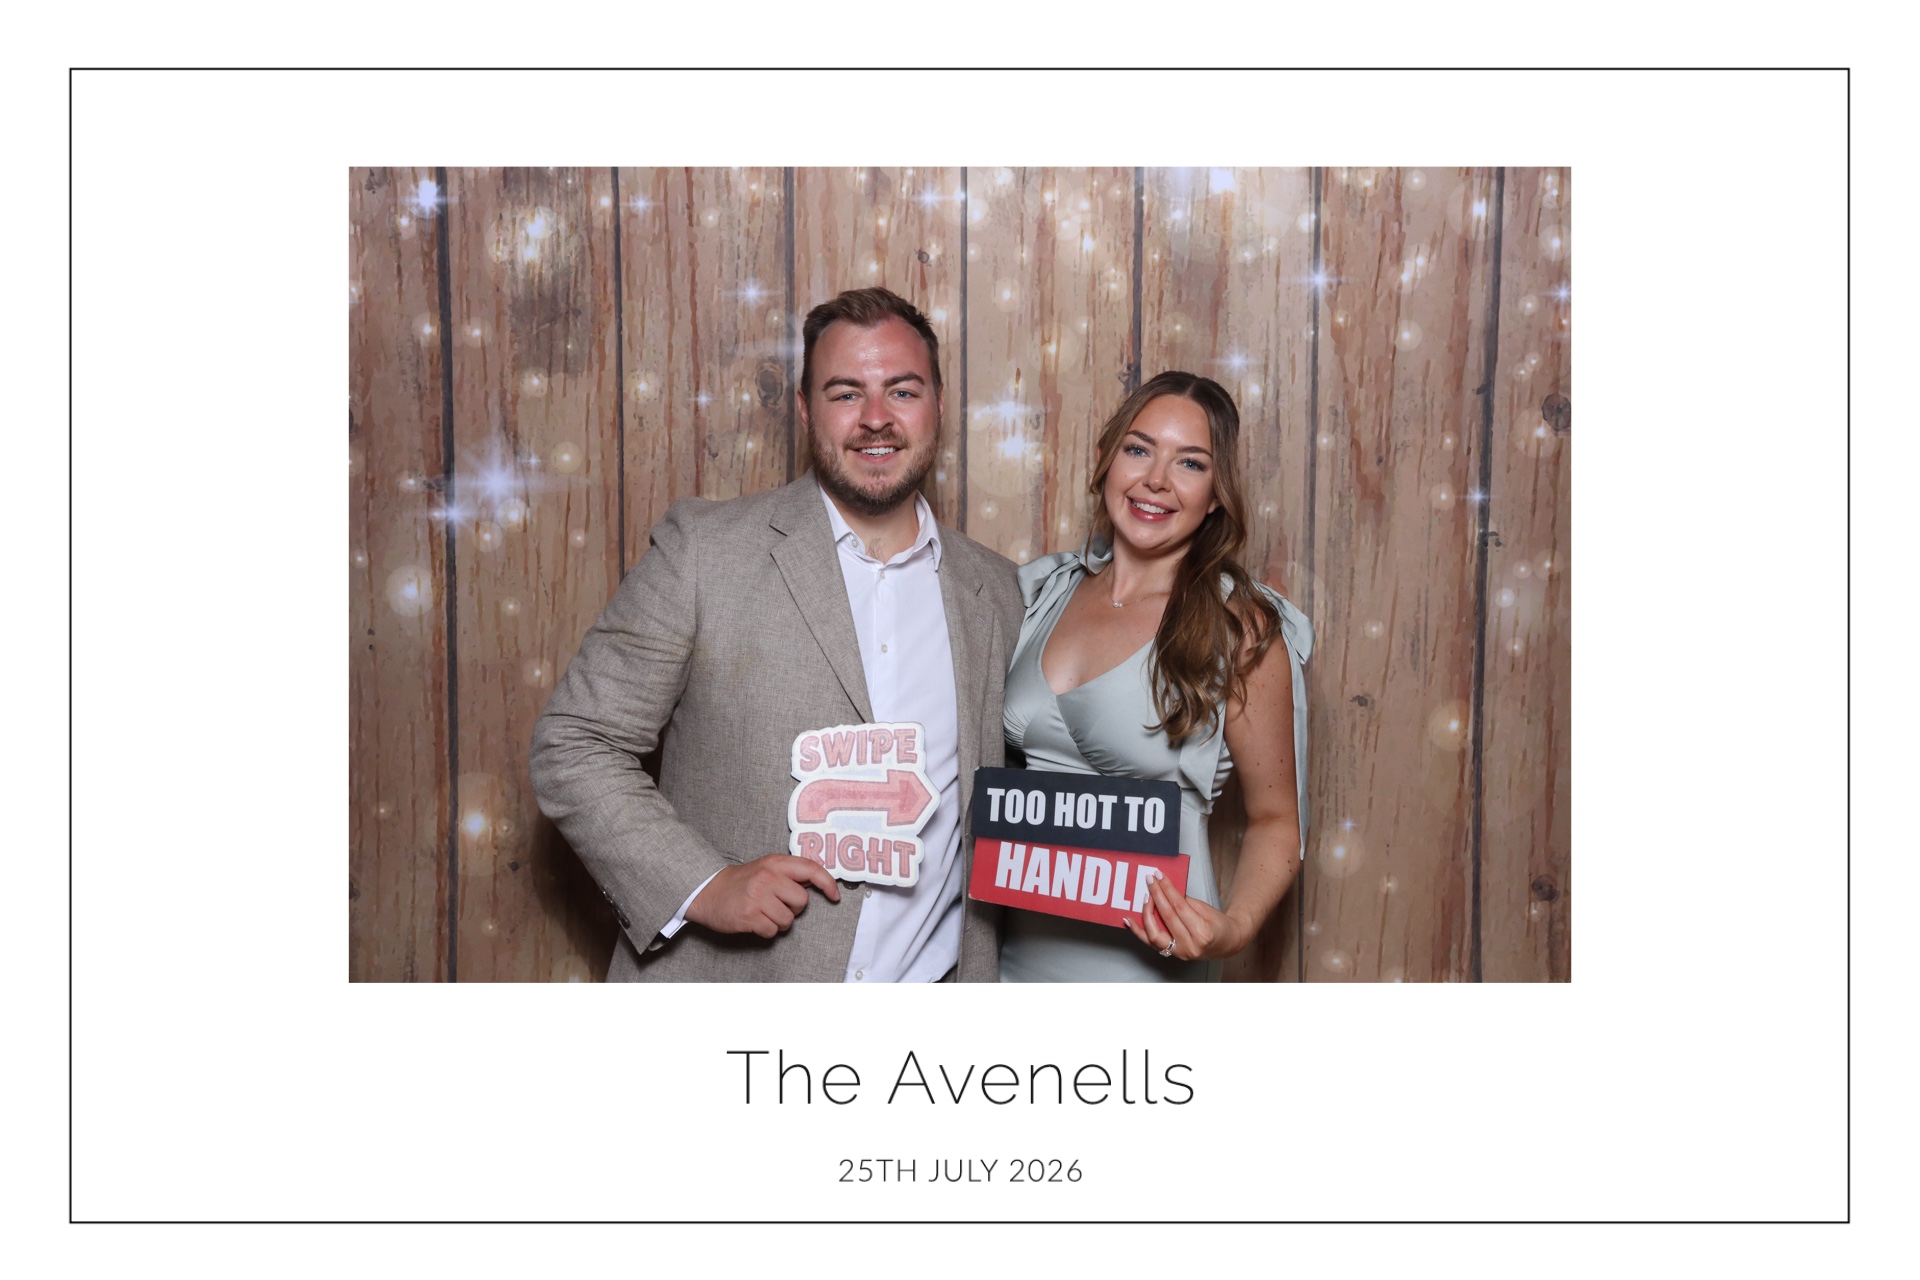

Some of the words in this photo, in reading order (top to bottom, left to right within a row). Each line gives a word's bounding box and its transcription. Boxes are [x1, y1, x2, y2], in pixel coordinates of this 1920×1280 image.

[800, 729, 918, 772] SWIPE
[987, 787, 1046, 826] TOO
[1053, 791, 1118, 830] HOT
[1124, 795, 1166, 834] TO
[797, 832, 916, 878] RIGHT
